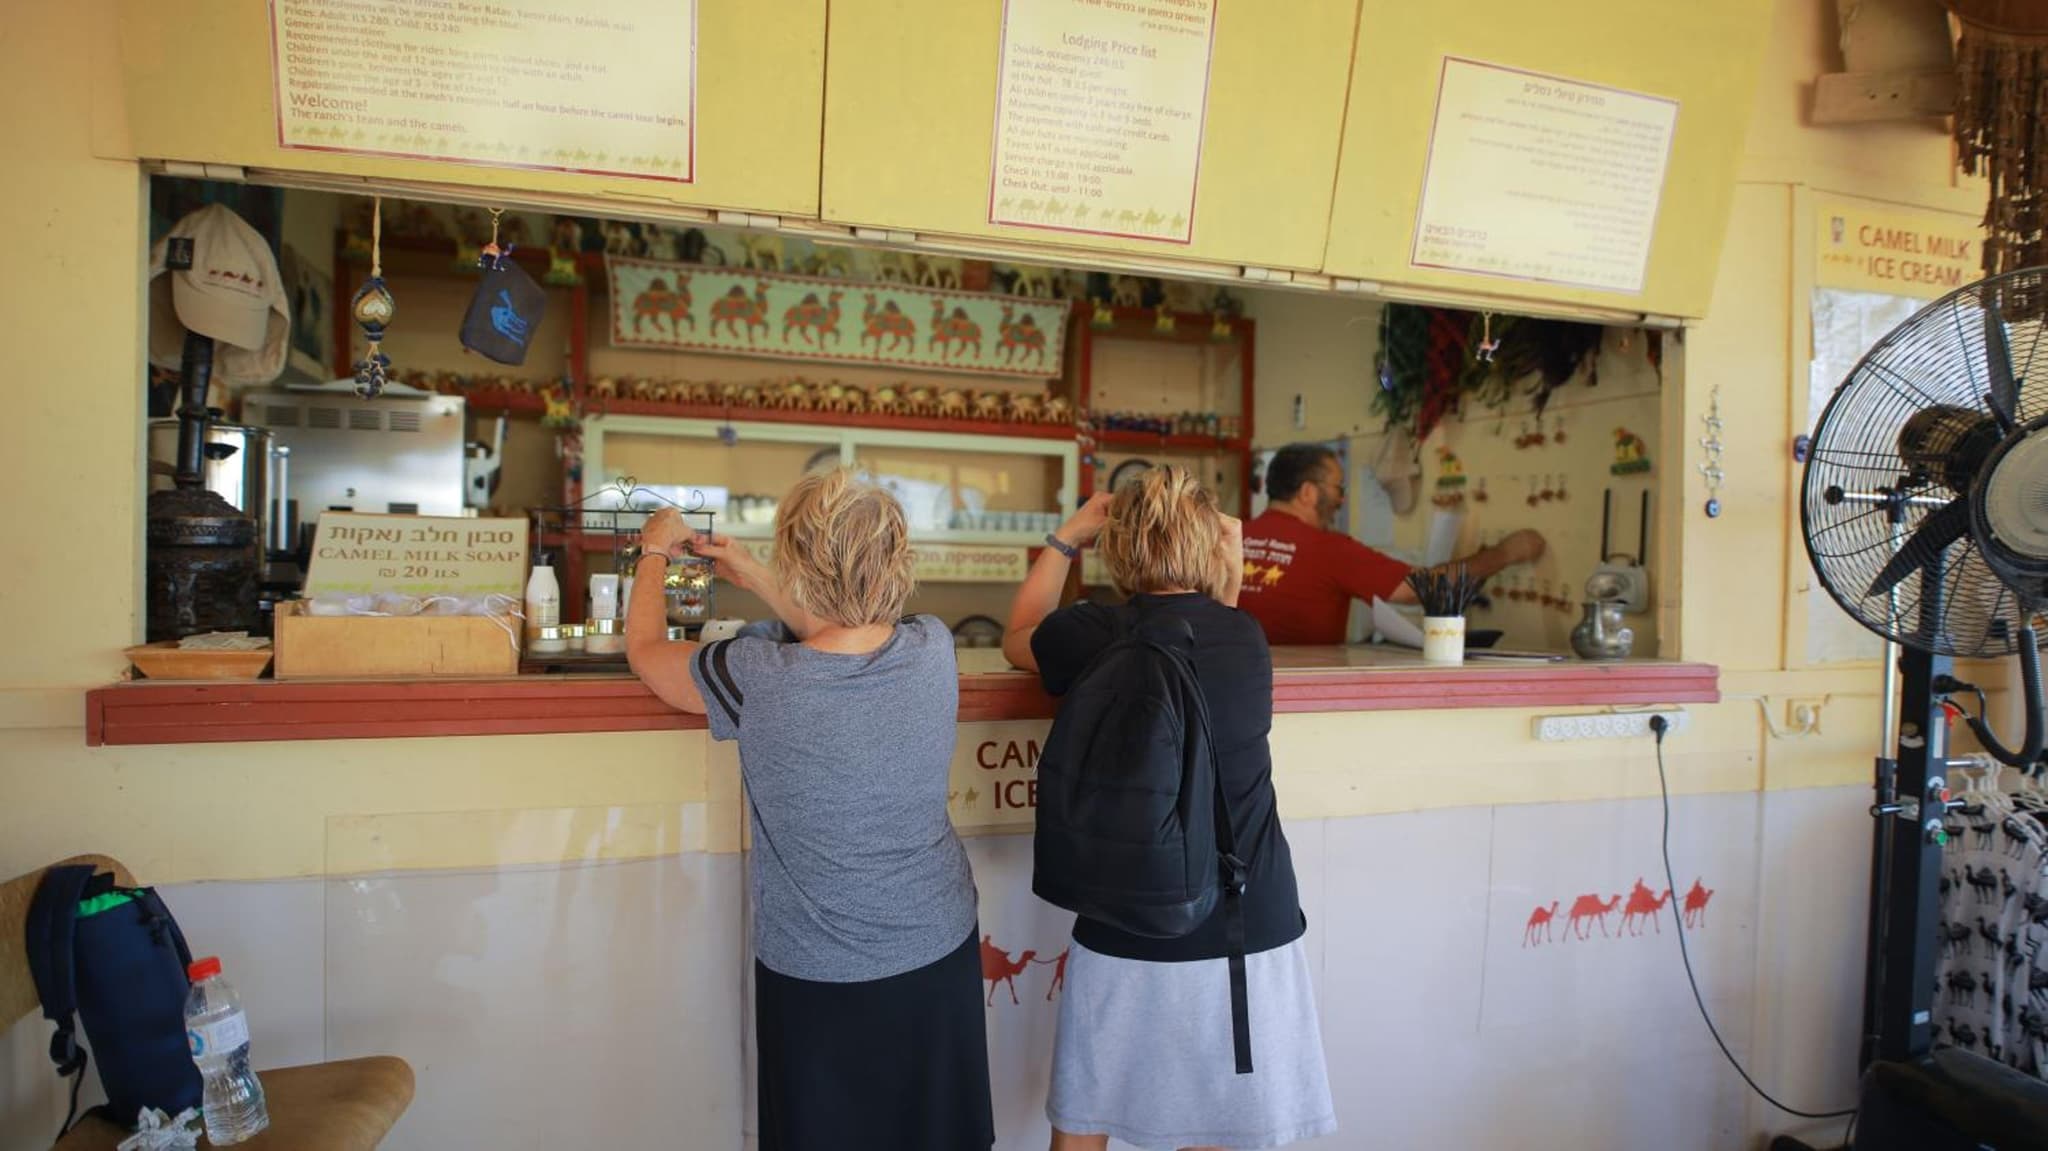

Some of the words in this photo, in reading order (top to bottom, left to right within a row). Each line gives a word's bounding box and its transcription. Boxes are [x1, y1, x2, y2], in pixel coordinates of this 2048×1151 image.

[286, 41, 328, 54] Children
[1062, 32, 1109, 51] Lodging
[1112, 39, 1138, 55] Price
[1141, 43, 1157, 58] list
[289, 92, 368, 112] Welcome!
[291, 107, 312, 119] The
[314, 109, 353, 123] ranch's
[356, 114, 384, 125] team
[386, 114, 407, 127] and
[409, 117, 428, 130] the
[1008, 112, 1024, 122] The
[1026, 115, 1063, 127] payment
[1123, 126, 1146, 139] credit
[1032, 140, 1053, 151] VAT
[1002, 177, 1029, 190] Check
[1859, 225, 1922, 254] CAMEL
[1927, 236, 1971, 260] MILK
[1868, 256, 1895, 279] ICE
[1901, 261, 1962, 286] CREAM
[329, 526, 402, 545] נאקות
[410, 526, 457, 543] חלב
[467, 530, 513, 548] סבון
[318, 547, 398, 560] CAMEL
[404, 550, 460, 562] MILK
[464, 551, 520, 563] SOAP
[403, 566, 428, 578] 20
